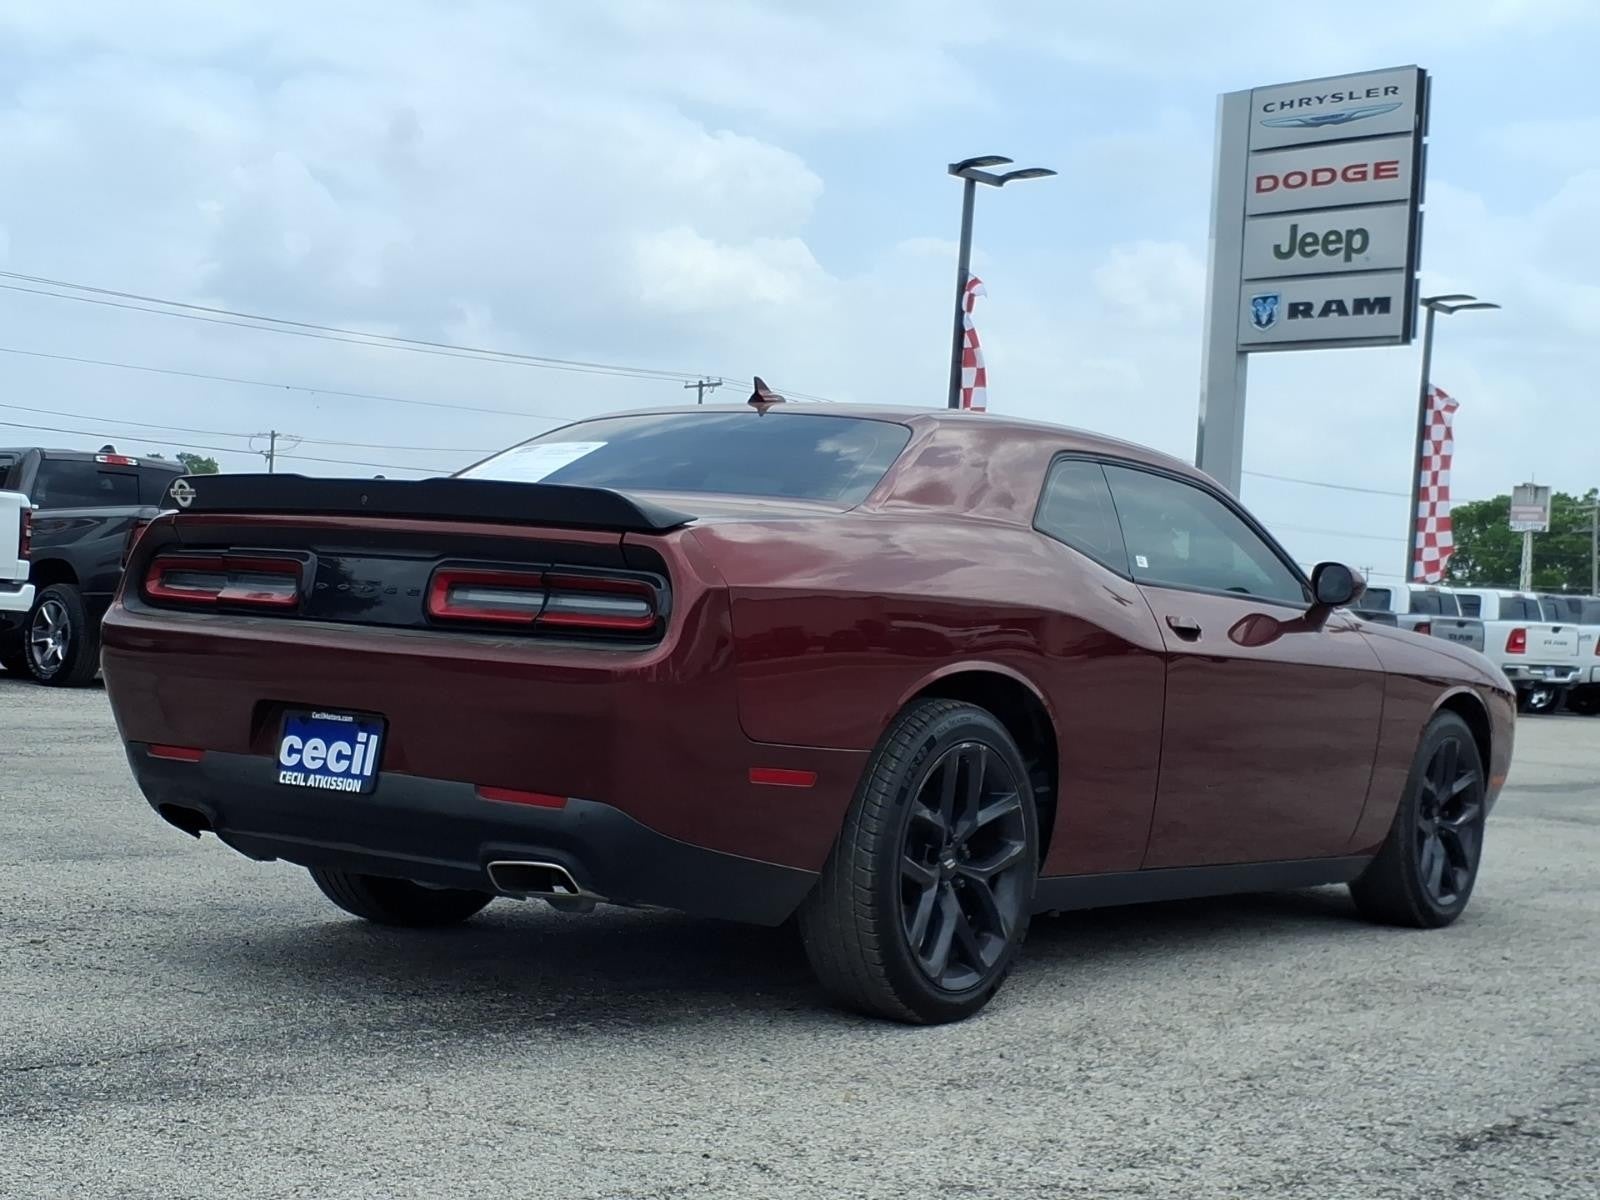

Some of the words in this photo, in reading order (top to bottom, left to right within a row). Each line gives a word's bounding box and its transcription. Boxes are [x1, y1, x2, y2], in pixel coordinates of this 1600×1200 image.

[1262, 85, 1400, 113] CHRYSLER
[1255, 160, 1400, 194] DODGE
[1273, 223, 1370, 263] Jeep
[1287, 296, 1393, 320] RAM
[279, 732, 378, 776] cecil
[279, 770, 305, 787] CECIL
[306, 774, 362, 793] ATKISSION
